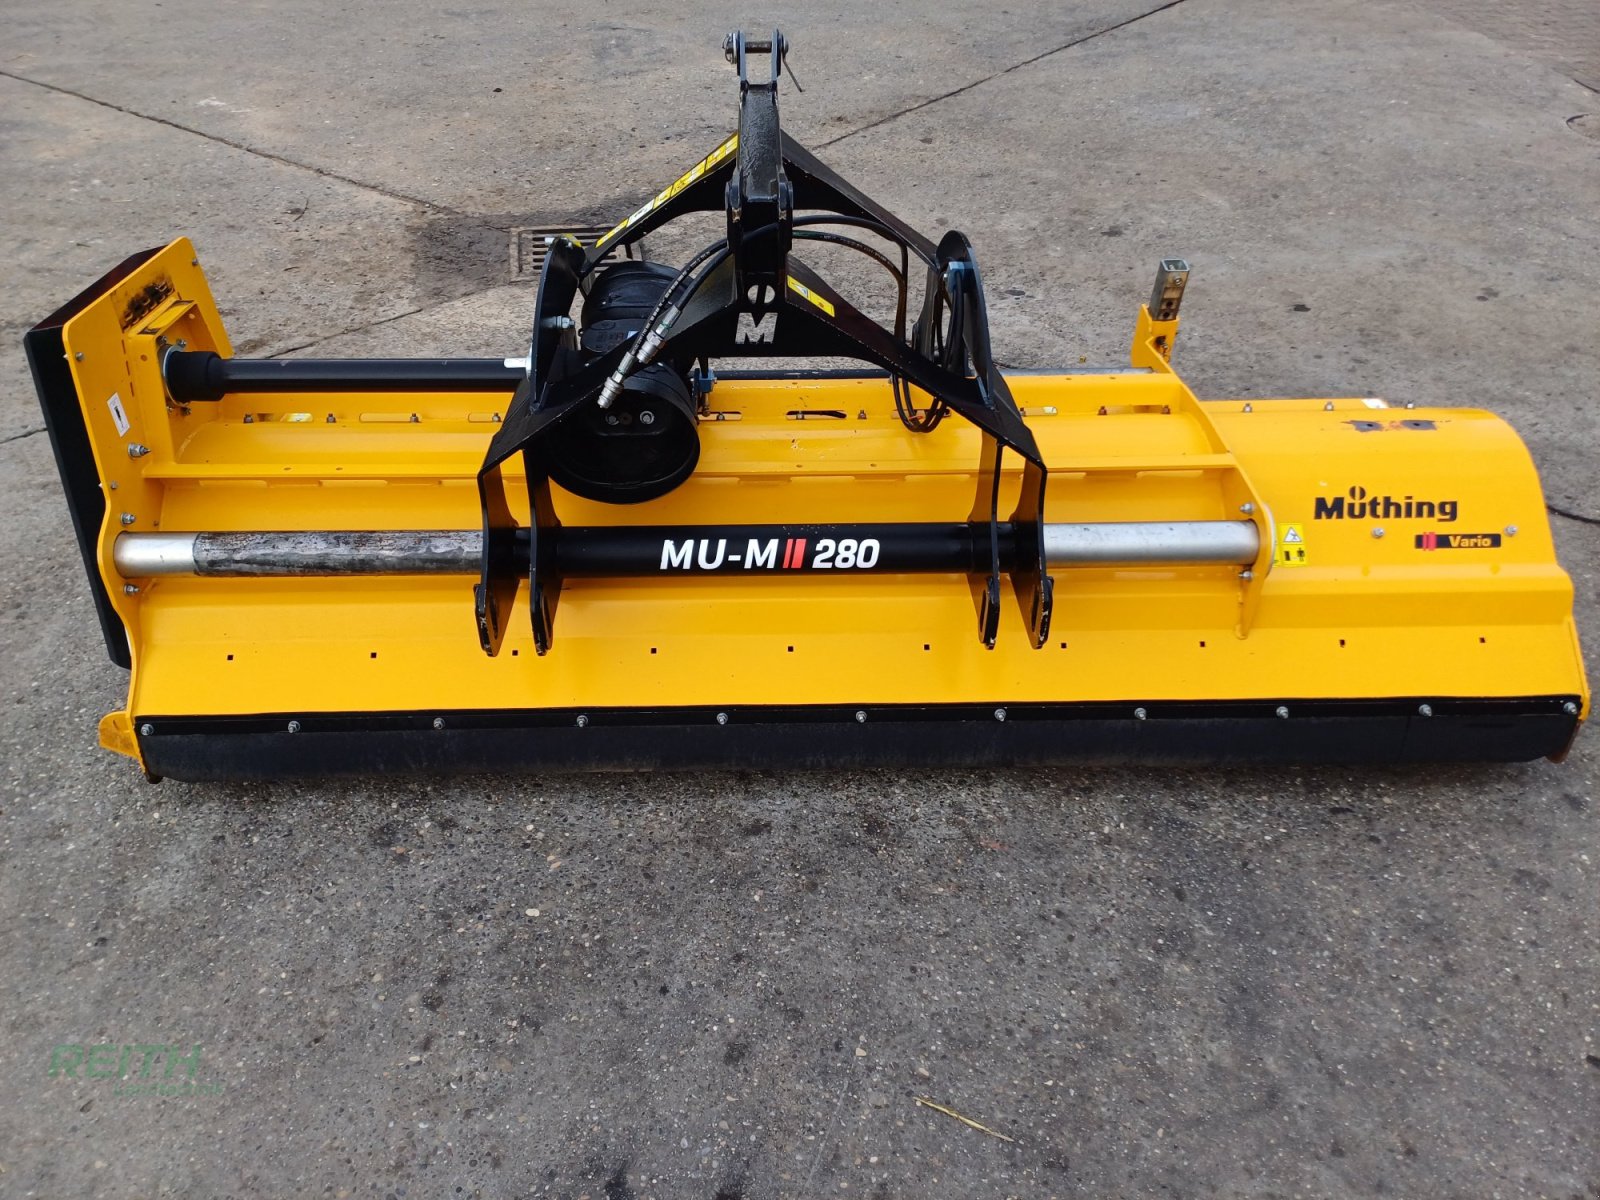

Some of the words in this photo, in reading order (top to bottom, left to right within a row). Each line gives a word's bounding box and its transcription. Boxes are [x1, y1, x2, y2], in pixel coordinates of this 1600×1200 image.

[1314, 485, 1458, 522] Müthing
[811, 538, 880, 569] 280
[1448, 534, 1492, 548] Vario
